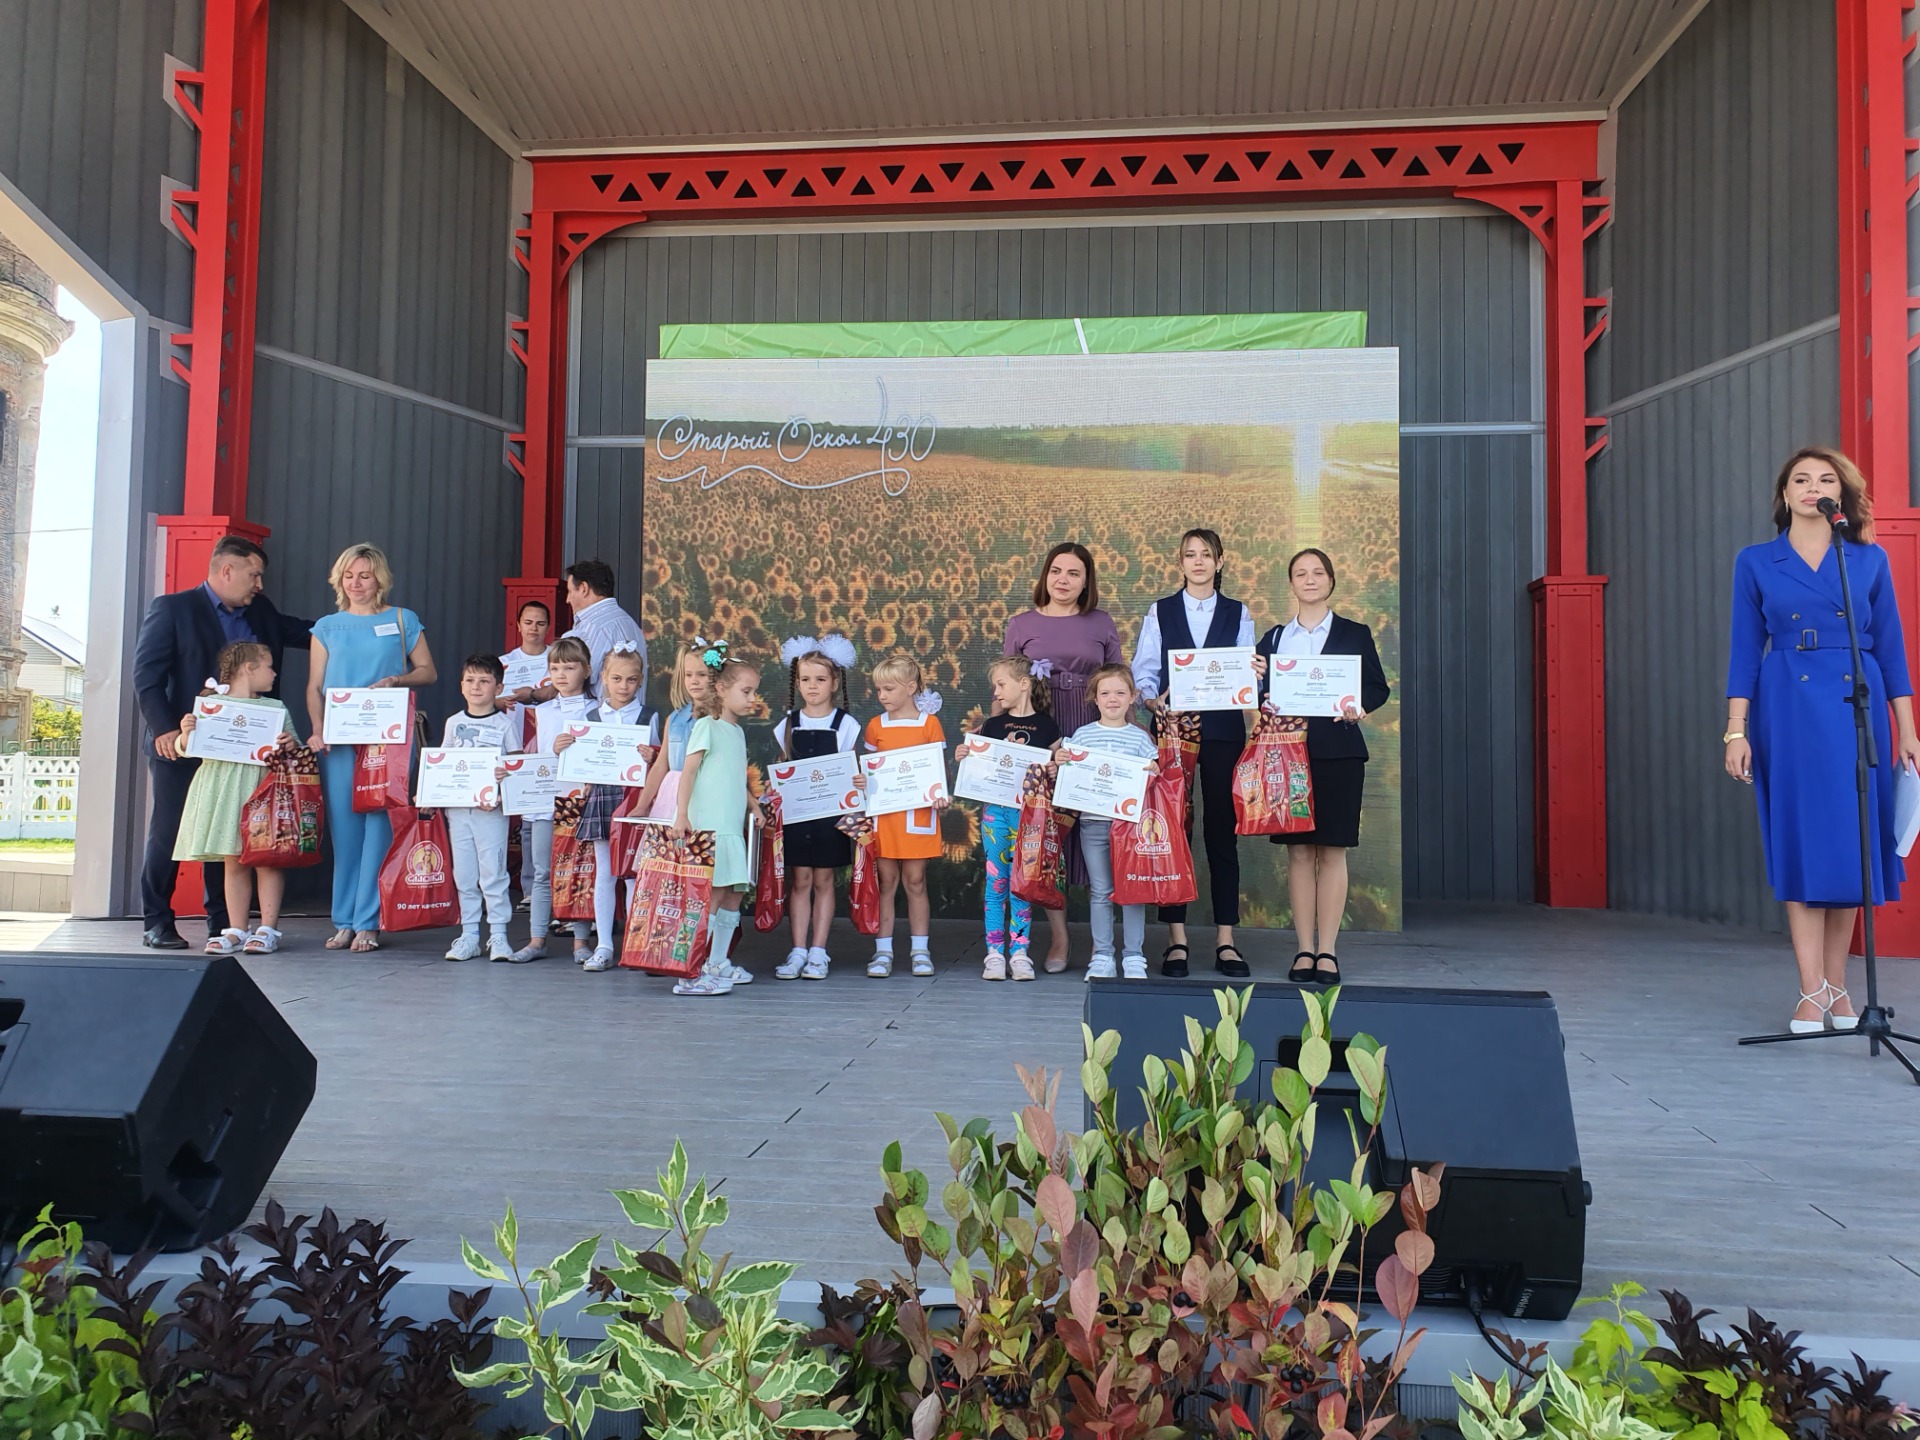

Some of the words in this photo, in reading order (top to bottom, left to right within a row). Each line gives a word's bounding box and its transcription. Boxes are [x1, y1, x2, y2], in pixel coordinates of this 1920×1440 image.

[657, 414, 772, 464] Старый
[777, 415, 861, 463] Оскол
[866, 377, 936, 478] 430
[1126, 873, 1136, 881] 90
[657, 906, 680, 918] СТЕП
